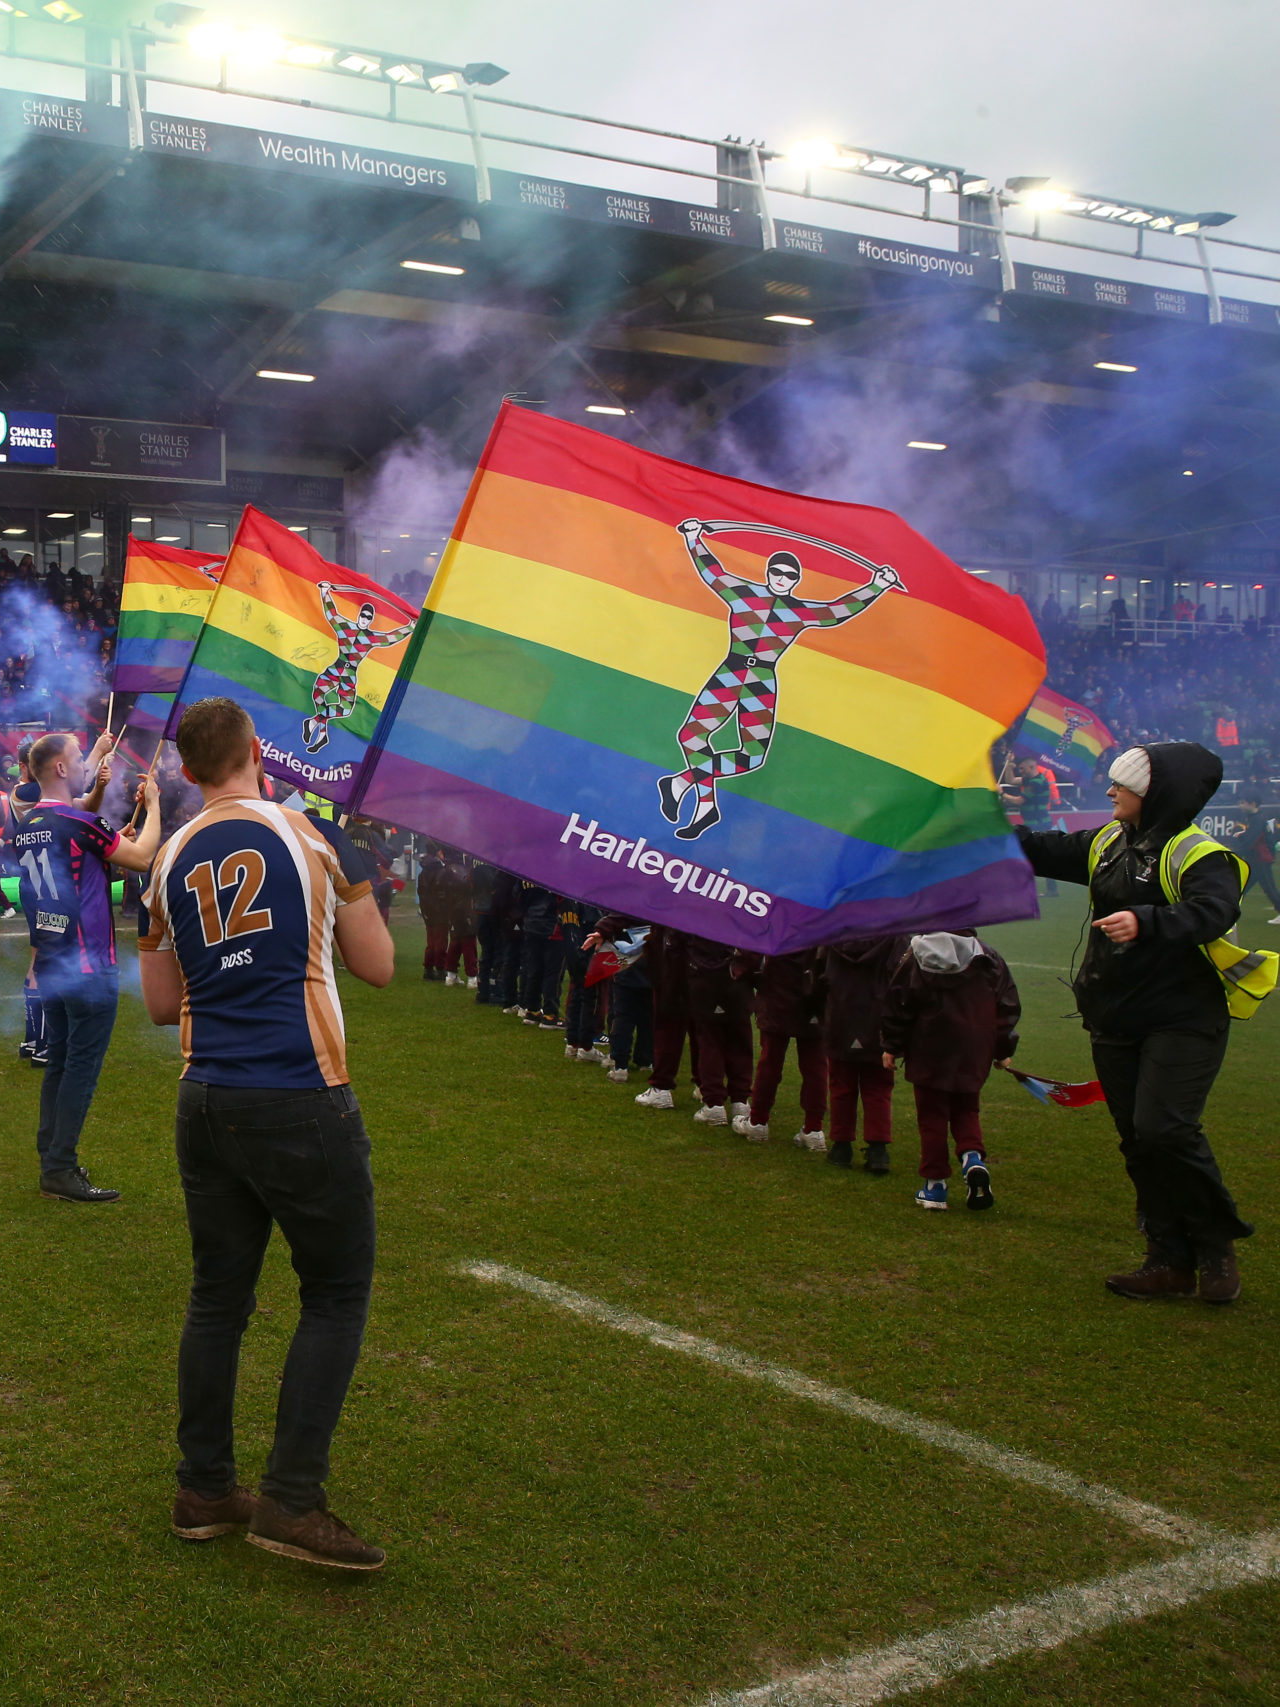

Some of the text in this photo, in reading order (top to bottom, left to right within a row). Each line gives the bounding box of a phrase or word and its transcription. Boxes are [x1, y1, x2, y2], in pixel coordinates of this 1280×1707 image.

[22, 99, 83, 120] CHARLES
[23, 113, 83, 133] STANLEY
[149, 119, 207, 140] CHARLES
[150, 133, 207, 152] STANLEY
[258, 136, 448, 187] Wealth Managers
[519, 180, 566, 199] CHARLES
[520, 192, 566, 210] STANLEY
[606, 195, 651, 213] CHARLES
[607, 207, 651, 224] STANLEY
[688, 209, 731, 227] CHARLES
[690, 221, 732, 237] STANLEY
[783, 226, 823, 243] CHARLES
[784, 237, 824, 254] STANLEY
[858, 239, 974, 277] #focusingonyou
[1032, 270, 1066, 285] CHARLES
[1032, 281, 1066, 295] STANLEY
[1094, 281, 1127, 296] CHARLES
[1095, 291, 1127, 305] STANLEY
[9, 426, 53, 438] CHARLES
[139, 432, 190, 447] CHARLES
[9, 436, 52, 449] STANLEY
[140, 445, 189, 459] STANLEY
[259, 738, 353, 783] Harlequins
[15, 830, 53, 847] CHESTER
[559, 812, 772, 918] Harlequins
[19, 848, 59, 901] 11
[184, 848, 273, 948] 12
[220, 948, 254, 971] ROSS
